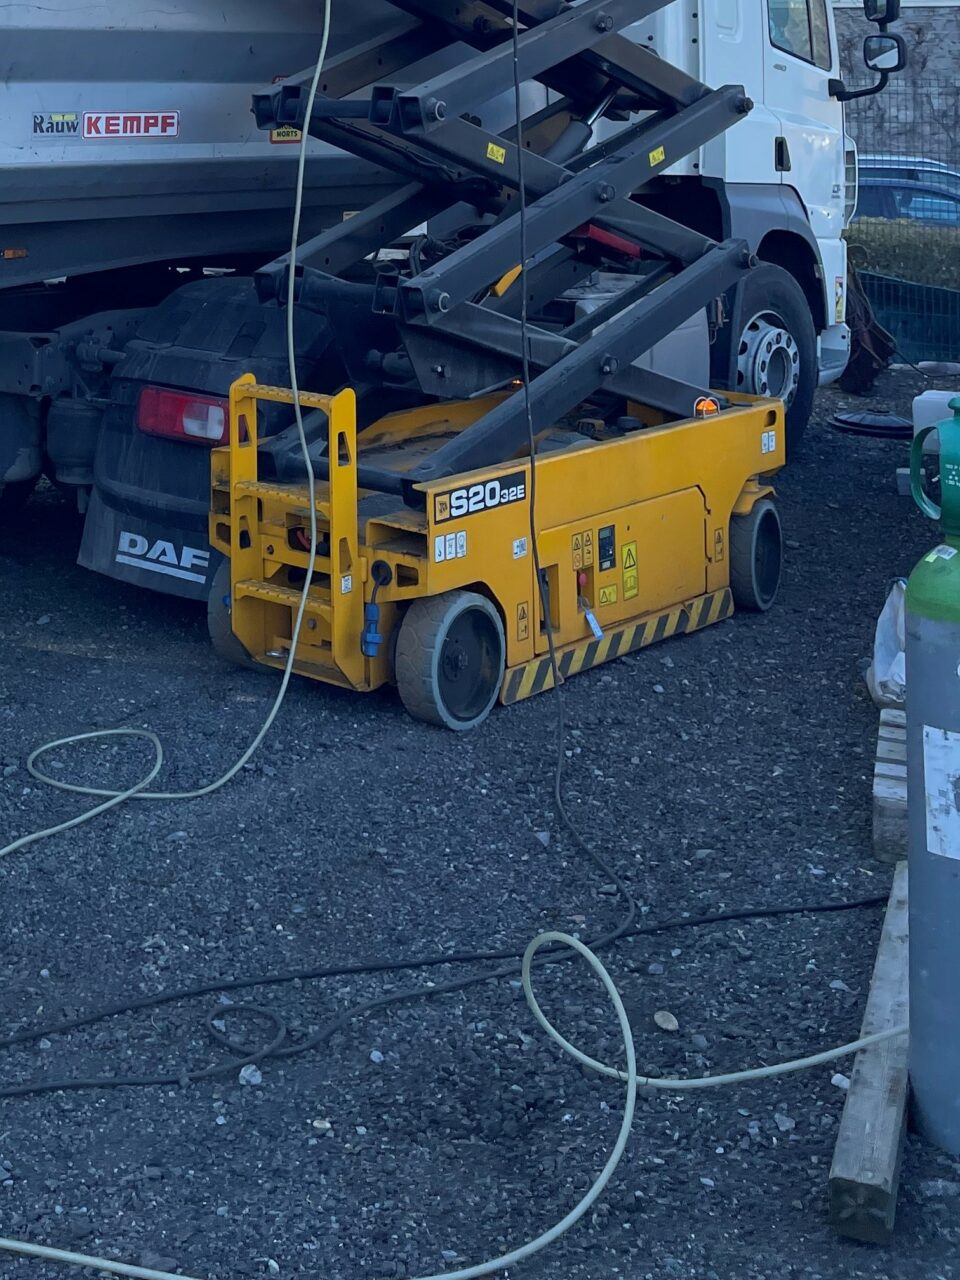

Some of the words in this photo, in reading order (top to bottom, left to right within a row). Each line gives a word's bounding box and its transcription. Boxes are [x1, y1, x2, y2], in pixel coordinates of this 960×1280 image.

[33, 114, 80, 133] Rauw
[87, 115, 175, 134] KEMPF
[117, 531, 210, 568] DAF
